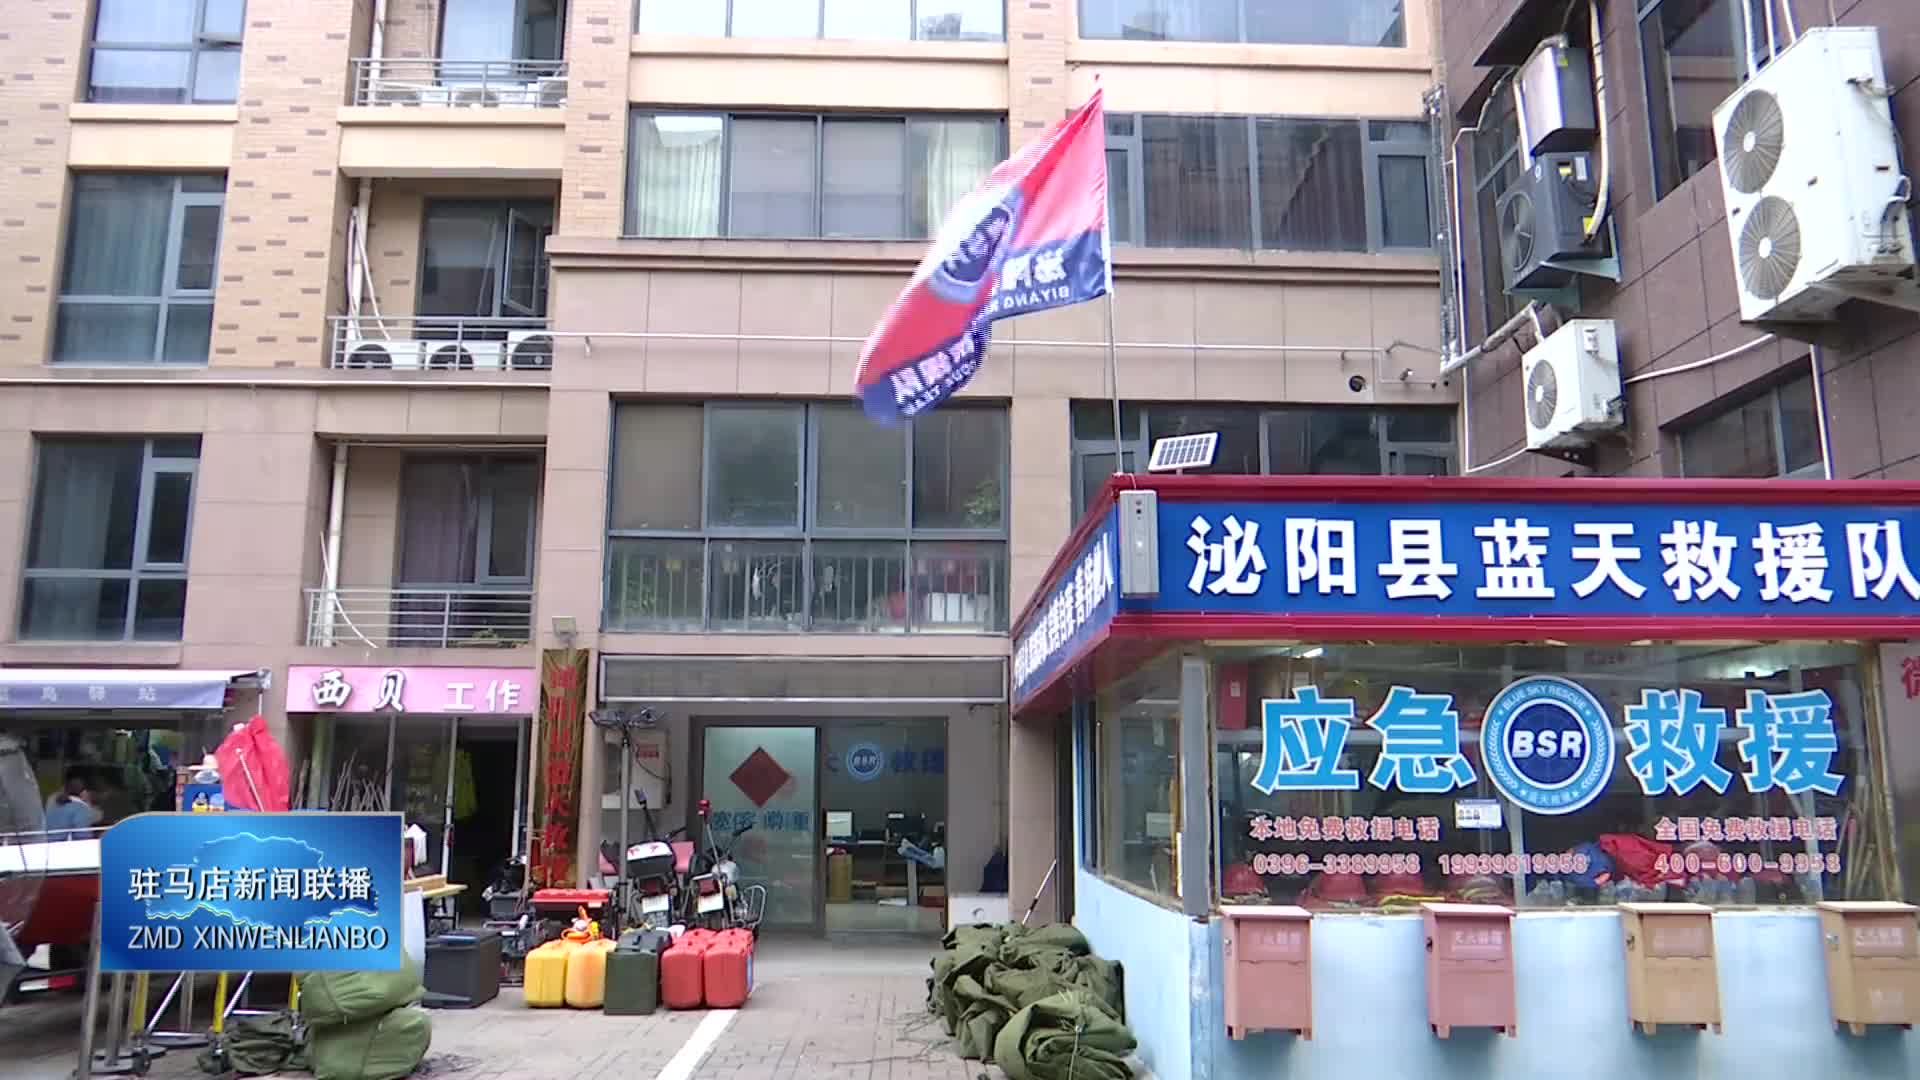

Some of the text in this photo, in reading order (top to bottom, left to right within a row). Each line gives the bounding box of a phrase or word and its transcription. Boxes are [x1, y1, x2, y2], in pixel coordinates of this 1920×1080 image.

[1187, 513, 1920, 603] 泌阳县蓝天救援队
[311, 669, 522, 713] 西贝 工作
[1502, 684, 1588, 709] BLUE SKY RESCUE
[1251, 684, 1845, 797] 应急 救援
[1511, 729, 1584, 759] BSR
[1249, 816, 1440, 840] 本地免费救援电话
[1654, 816, 1838, 841] 全国免费救援电话
[1252, 853, 1590, 875] 0396-3389958 19939819958
[1653, 853, 1840, 873] 400-600-9958
